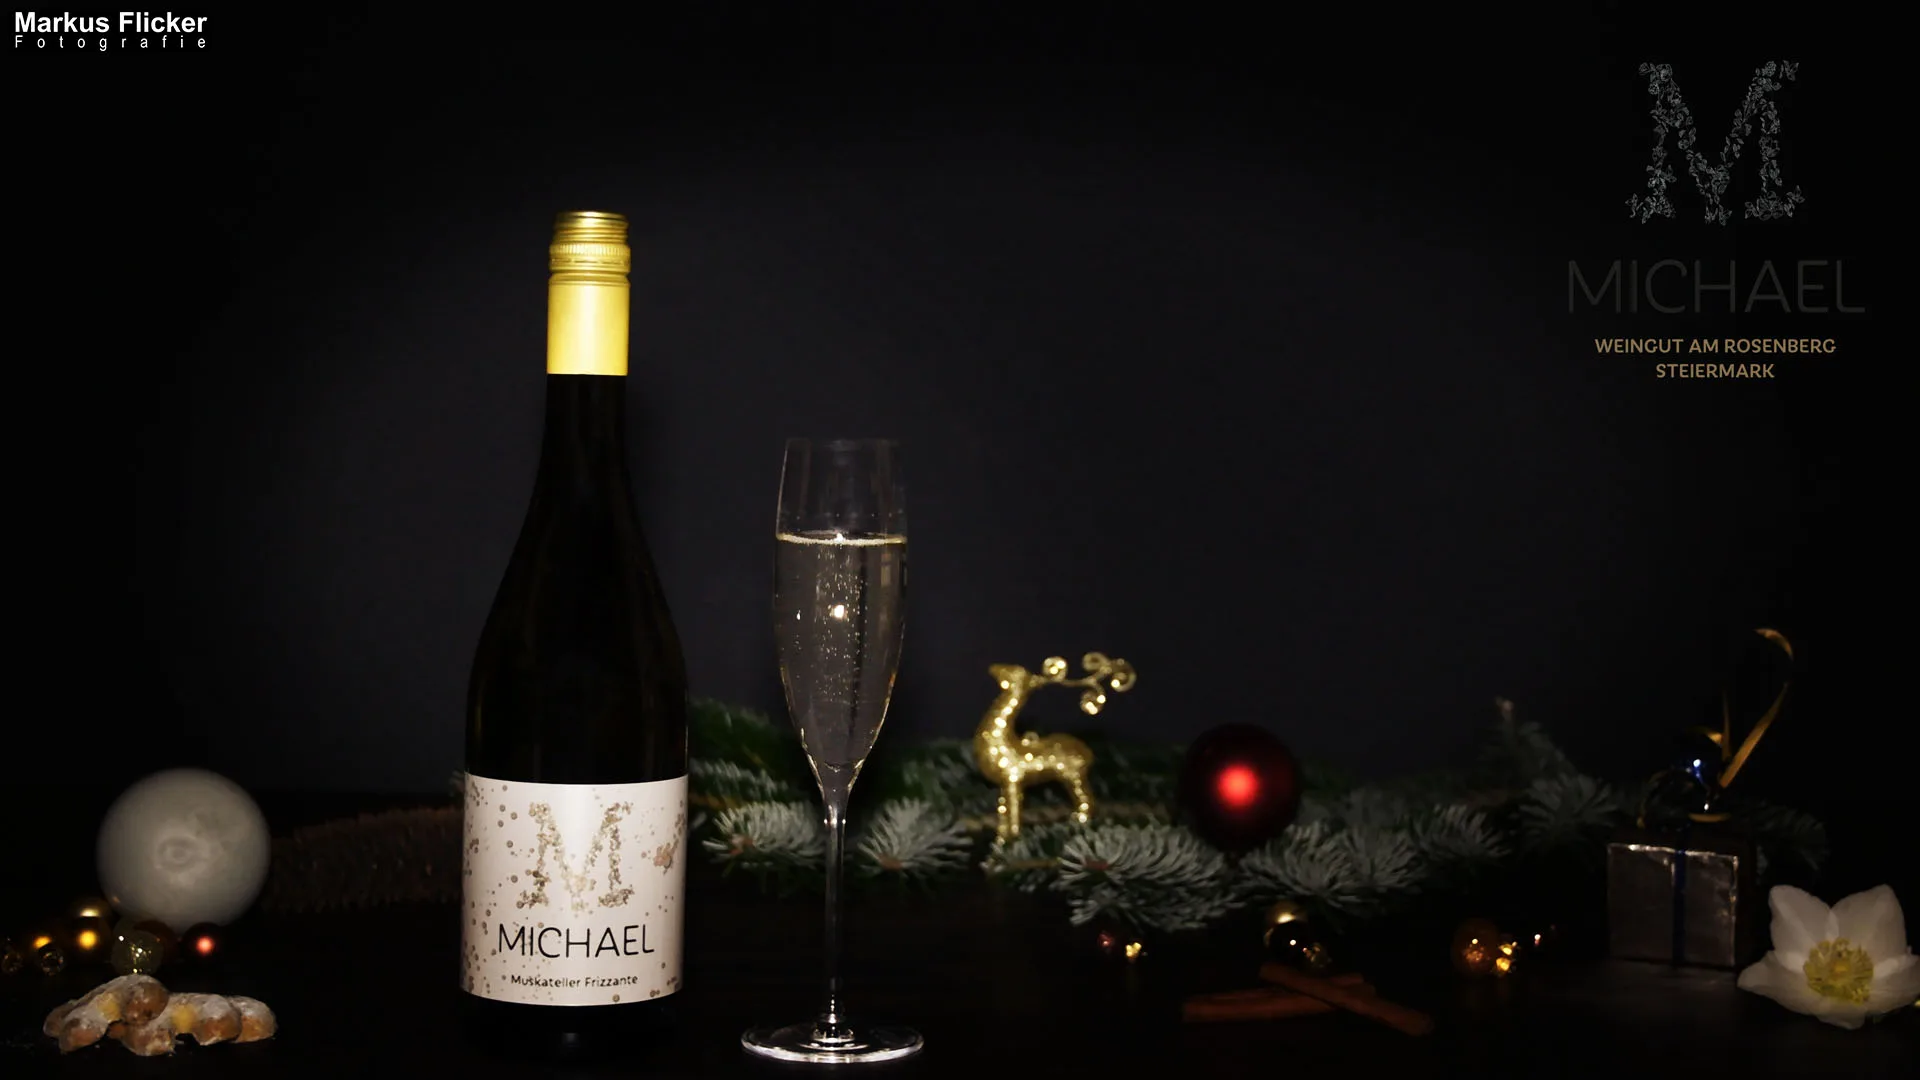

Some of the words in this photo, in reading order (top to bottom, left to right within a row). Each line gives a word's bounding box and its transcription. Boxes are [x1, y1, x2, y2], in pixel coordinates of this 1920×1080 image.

[499, 923, 654, 958] MICHAEL
[511, 975, 580, 988] Muskateller
[585, 976, 638, 988] Frizzante
